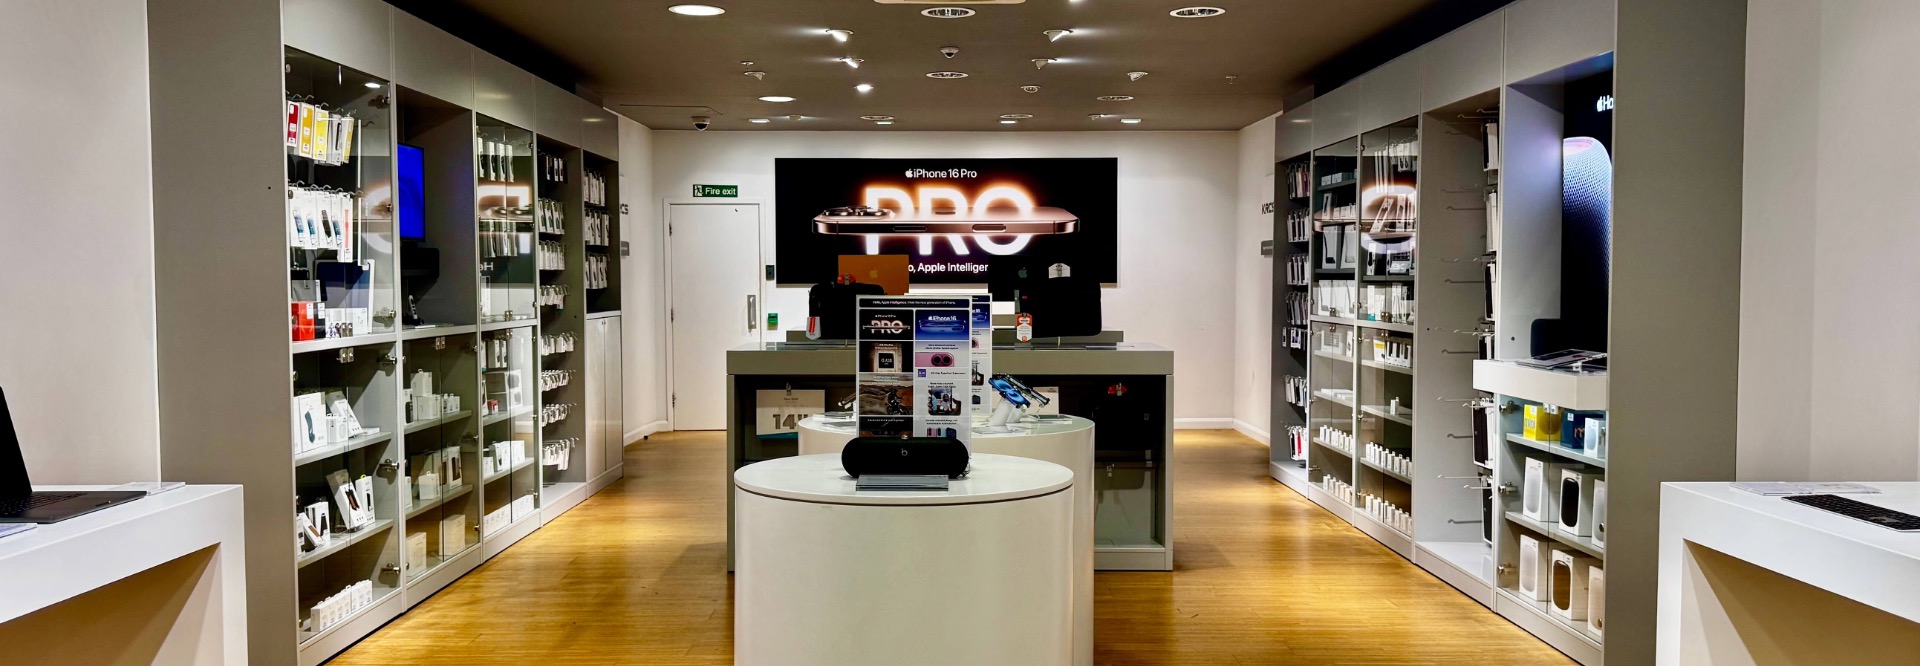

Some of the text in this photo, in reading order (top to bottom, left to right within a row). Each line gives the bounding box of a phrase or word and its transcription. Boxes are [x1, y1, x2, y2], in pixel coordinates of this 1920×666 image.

[913, 168, 977, 178] iPhone 16 Pro
[705, 187, 736, 195] Fire exit
[866, 187, 1033, 255] PRO
[918, 262, 945, 273] Apple
[871, 320, 903, 334] PRO
